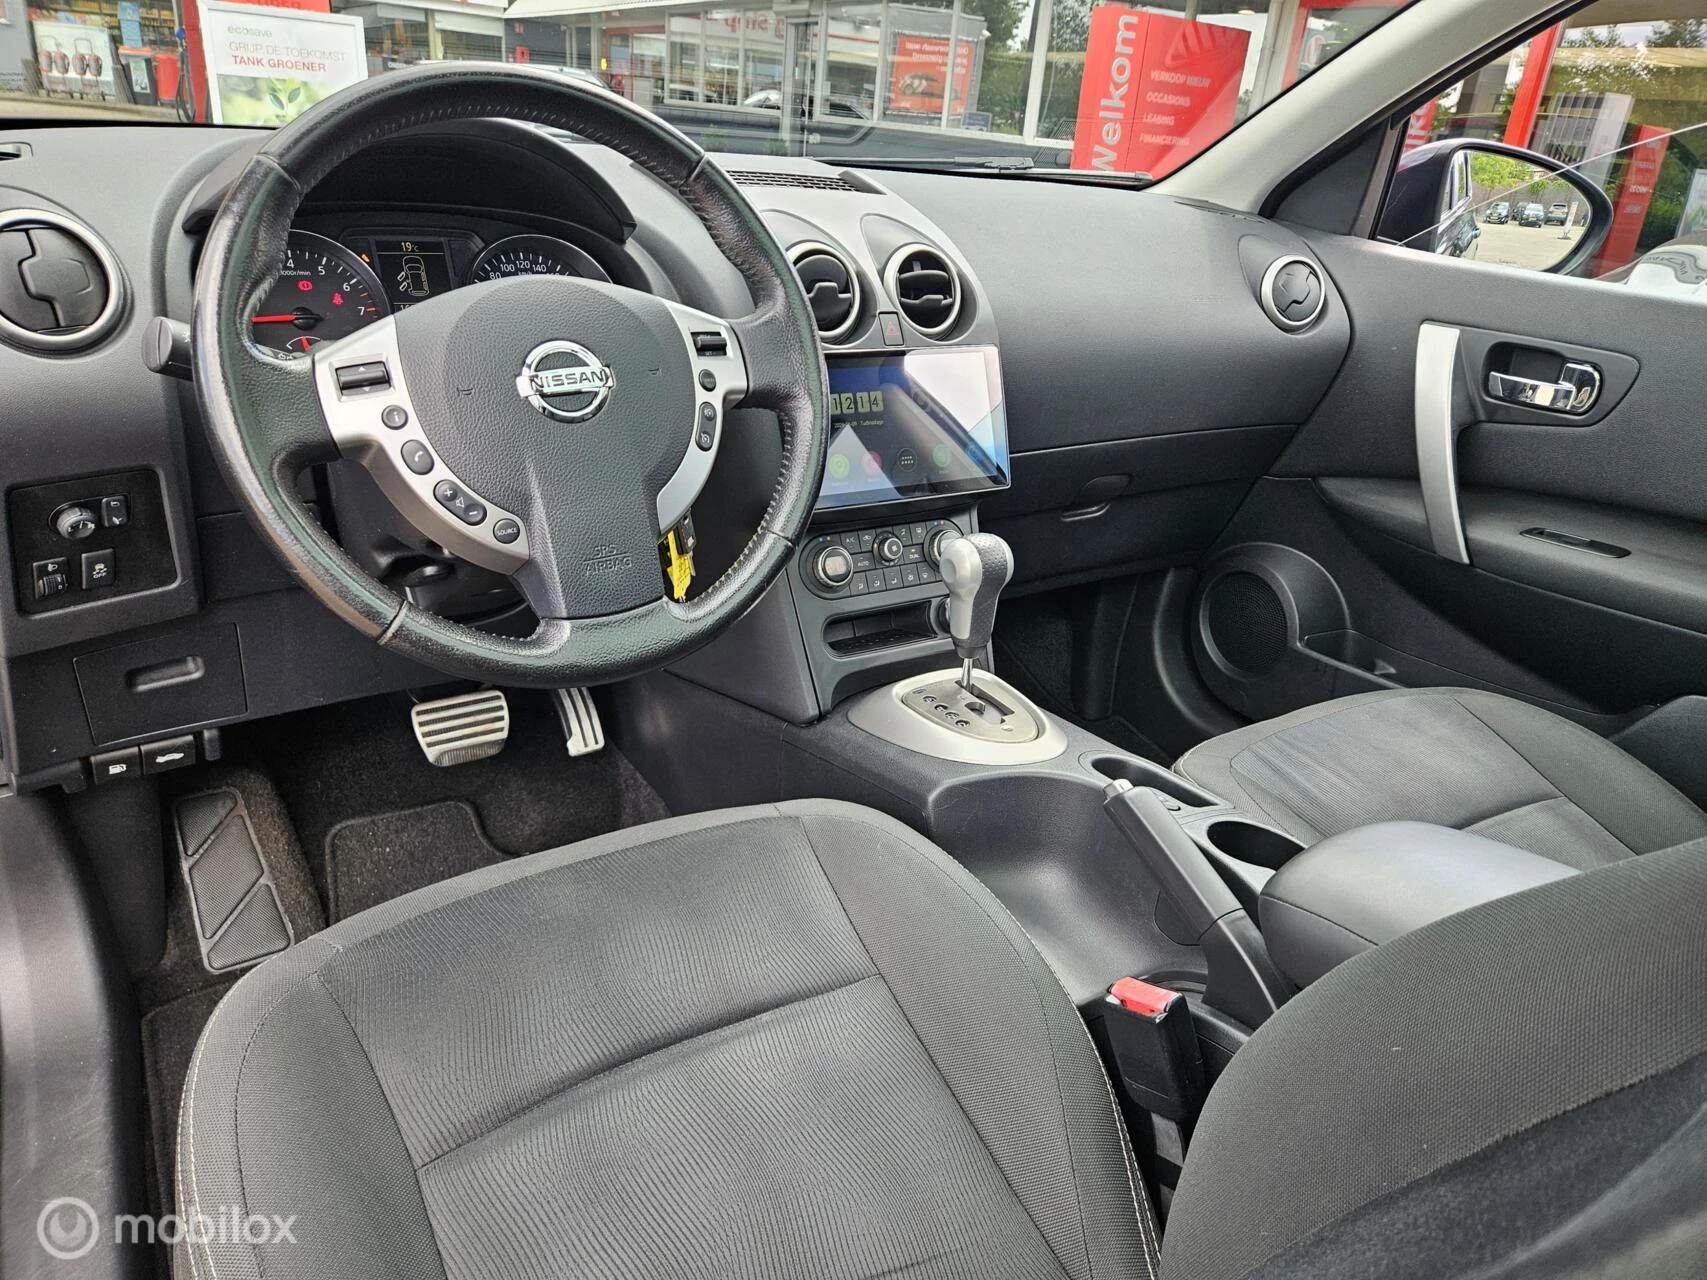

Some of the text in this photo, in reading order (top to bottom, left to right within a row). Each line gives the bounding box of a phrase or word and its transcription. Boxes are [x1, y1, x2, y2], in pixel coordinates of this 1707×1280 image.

[266, 46, 281, 56] DE
[285, 47, 345, 61] TOEKOMST
[232, 55, 326, 72] TANK GROENER
[1092, 15, 1138, 171] Welkom
[287, 259, 295, 268] 4
[500, 264, 515, 272] 100
[533, 264, 547, 272] 140
[318, 266, 326, 275] 5
[489, 272, 501, 280] 80
[343, 283, 350, 291] 6
[358, 306, 365, 315] 7
[530, 370, 605, 391] NISSAN
[496, 527, 517, 536] SOURCE
[585, 557, 632, 575] AIRBAG
